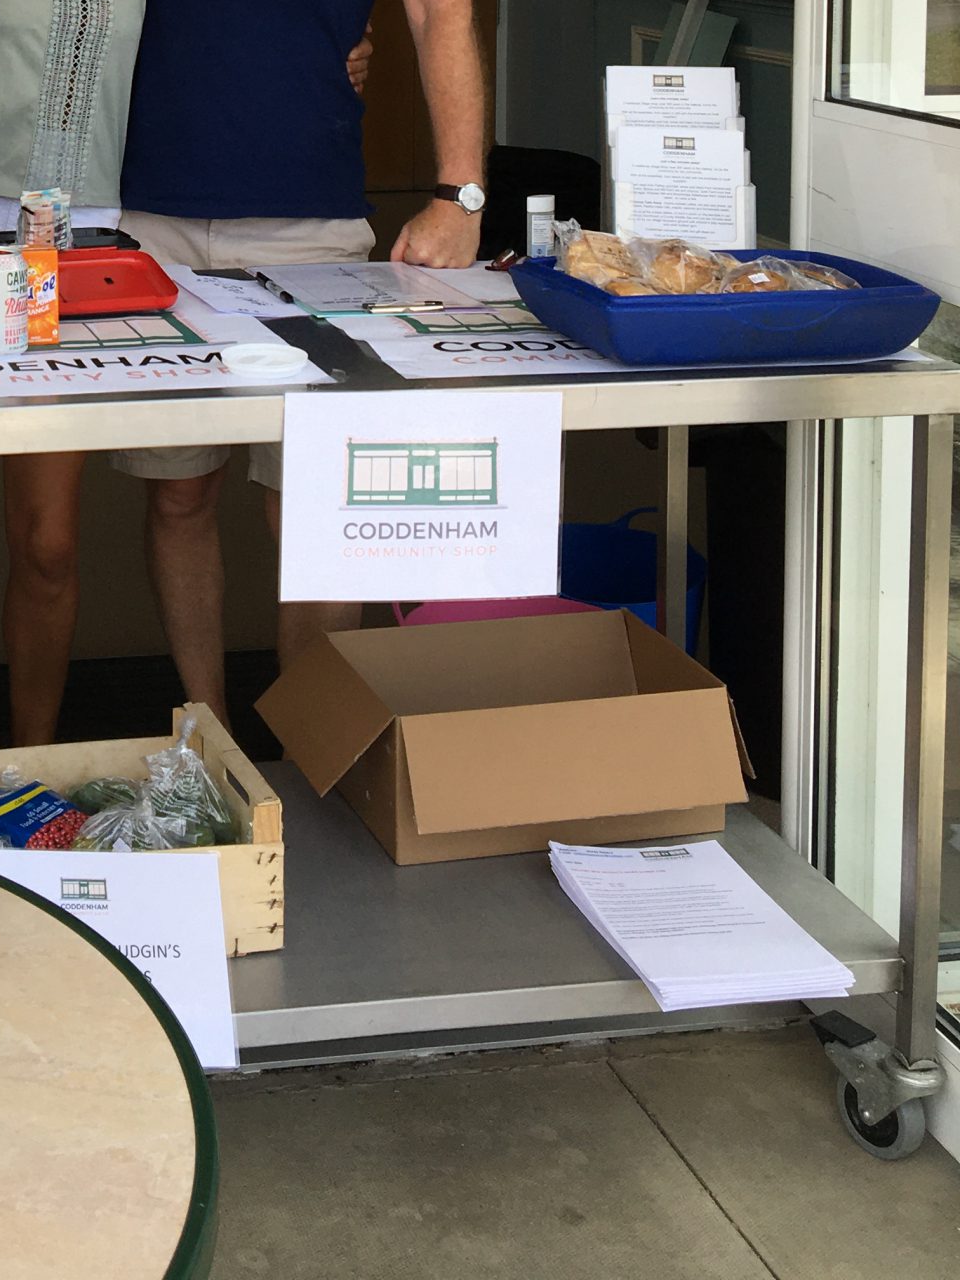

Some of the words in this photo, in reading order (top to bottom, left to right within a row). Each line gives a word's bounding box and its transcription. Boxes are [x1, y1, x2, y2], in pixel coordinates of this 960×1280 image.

[343, 521, 498, 540] CODDENHAM
[343, 545, 446, 558] COMMUNITY
[453, 545, 497, 557] SHOP
[60, 903, 108, 911] CODDENHAM
[118, 944, 181, 959] UDGIN'S
